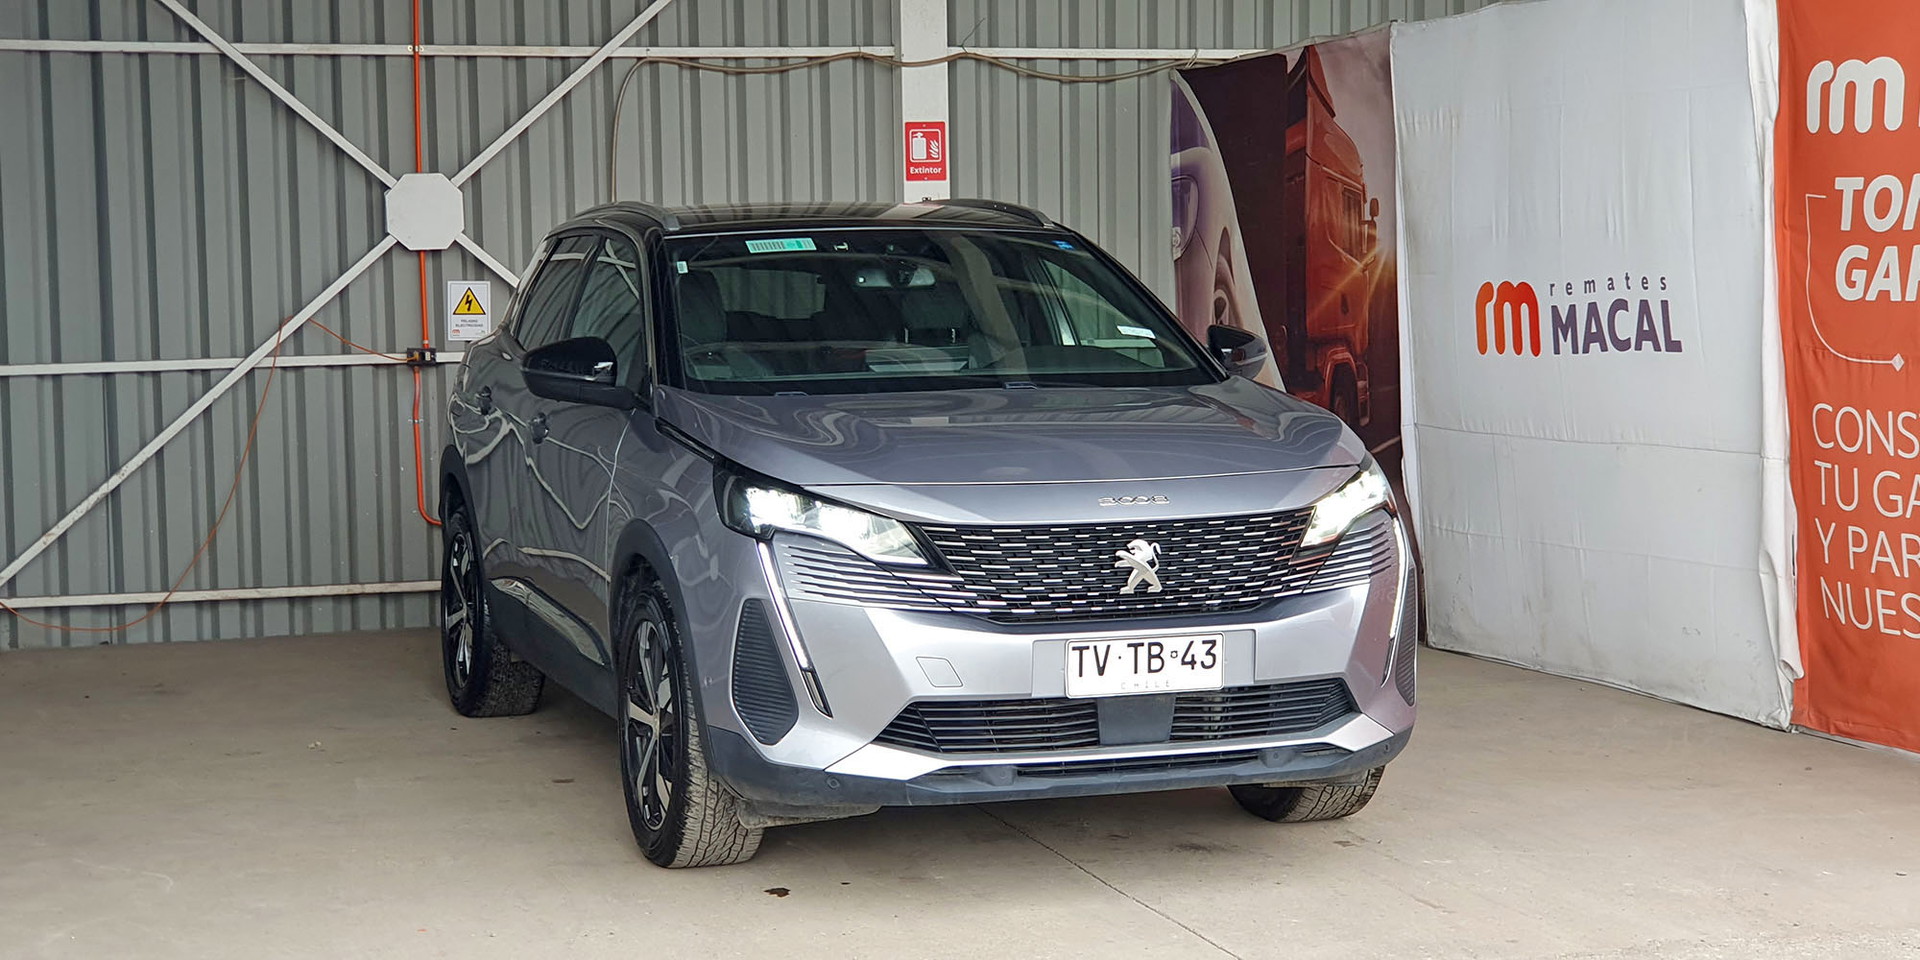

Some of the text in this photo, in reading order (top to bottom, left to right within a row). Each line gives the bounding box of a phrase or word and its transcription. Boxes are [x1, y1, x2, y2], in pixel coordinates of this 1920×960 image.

[909, 166, 942, 175] Extintor
[1550, 272, 1667, 296] remates
[1551, 298, 1683, 355] MACAL
[1812, 403, 1920, 459] CONS
[1814, 459, 1859, 512] TU
[1815, 517, 1920, 578] Y PAR
[1820, 576, 1920, 639] NUES
